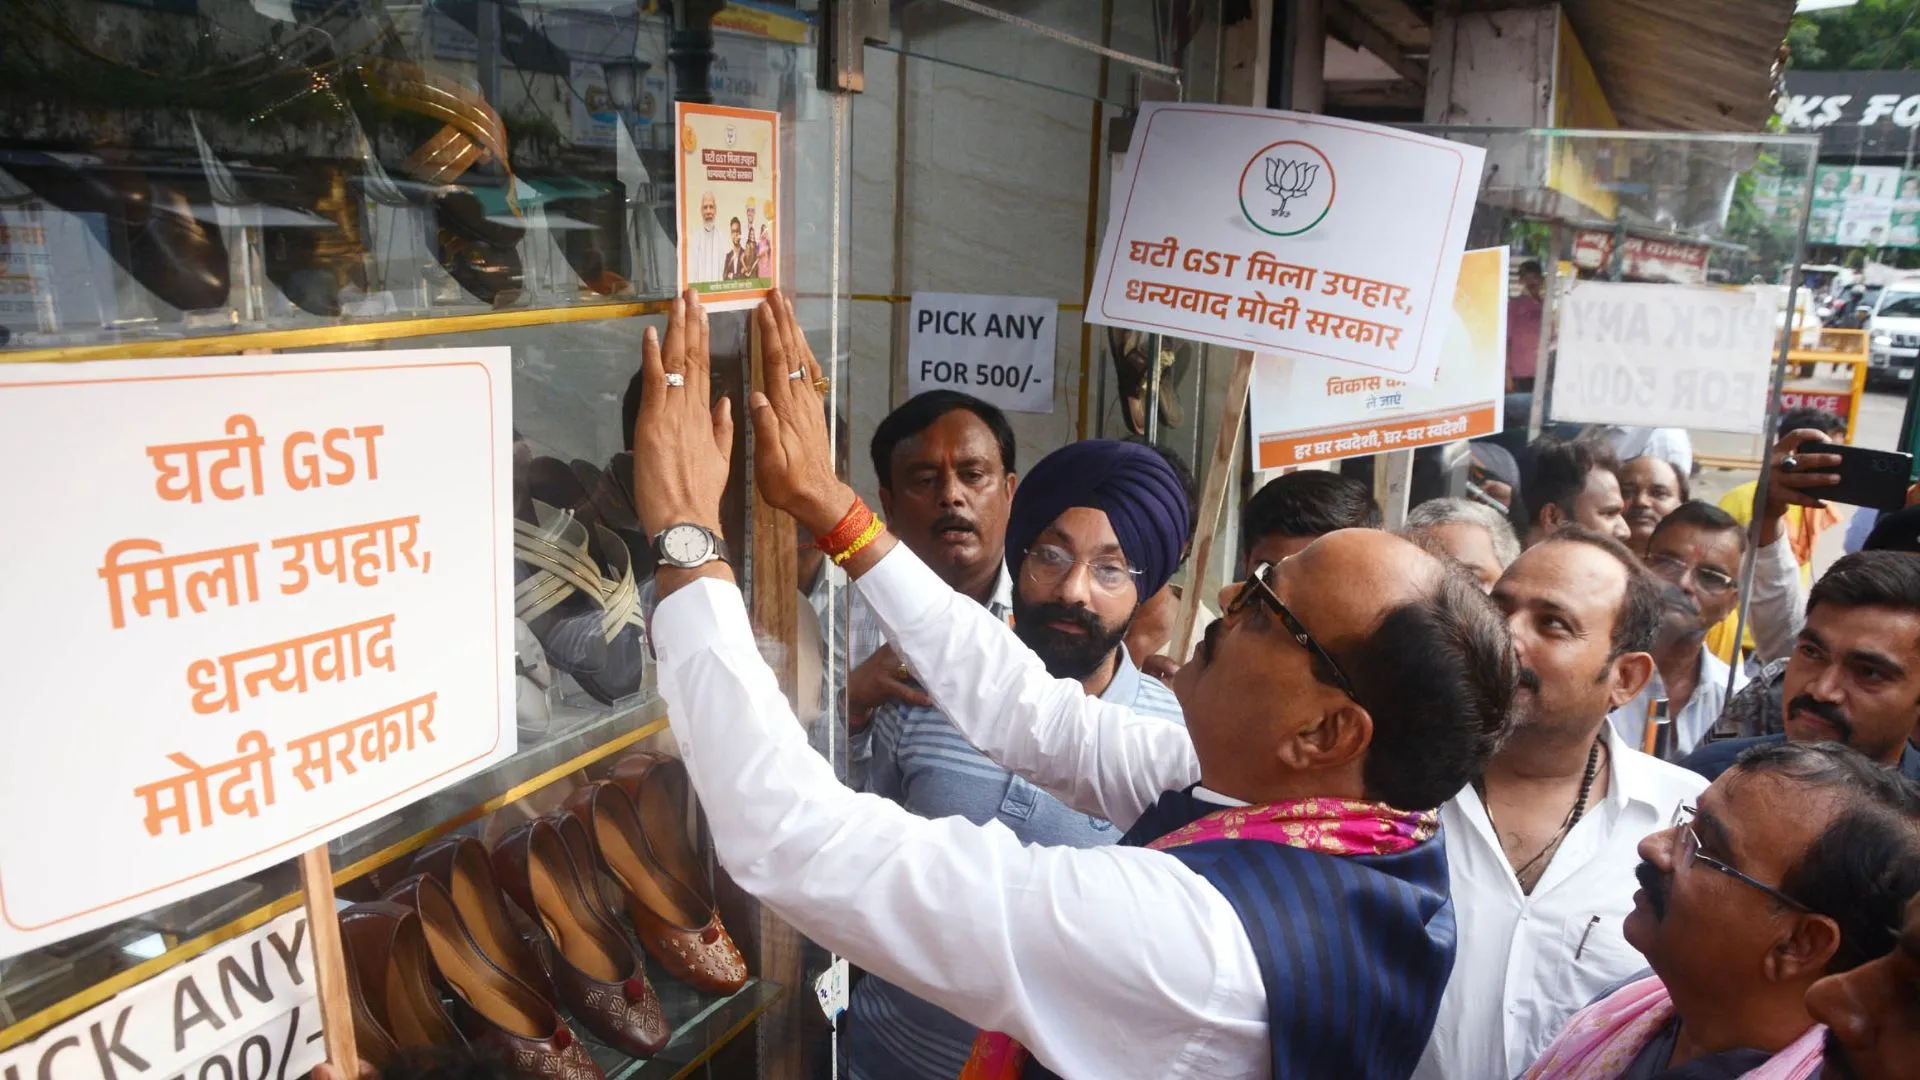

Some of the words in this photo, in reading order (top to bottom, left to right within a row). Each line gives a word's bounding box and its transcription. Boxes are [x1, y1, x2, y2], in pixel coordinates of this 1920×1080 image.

[1780, 94, 1852, 130] KS
[1130, 237, 1179, 268] घटी
[1182, 248, 1242, 278] GST
[1247, 250, 1318, 291] मिला
[1321, 271, 1413, 316] उपहार,
[917, 309, 977, 337] PICK
[983, 313, 1045, 340] ANY
[1125, 279, 1233, 320] धन्यवाद
[1237, 290, 1301, 330] मोदी
[1305, 309, 1404, 351] सरकार
[920, 360, 969, 385] FOR
[976, 363, 1042, 393] 500/-
[1326, 375, 1381, 396] विकास
[1780, 394, 1839, 409] OLICE
[144, 412, 266, 505] घटी
[282, 424, 385, 492] GST
[1294, 443, 1313, 460] हर
[1313, 441, 1333, 455] घर
[1335, 429, 1382, 452] स्वदेशी,
[1426, 415, 1468, 438] स्वदेशी
[96, 537, 261, 630] मिला
[271, 514, 433, 596] उपहार,
[185, 613, 396, 716] धन्यवाद
[132, 729, 276, 838] मोदी
[286, 691, 438, 791] सरकार
[174, 918, 307, 1052] ANY
